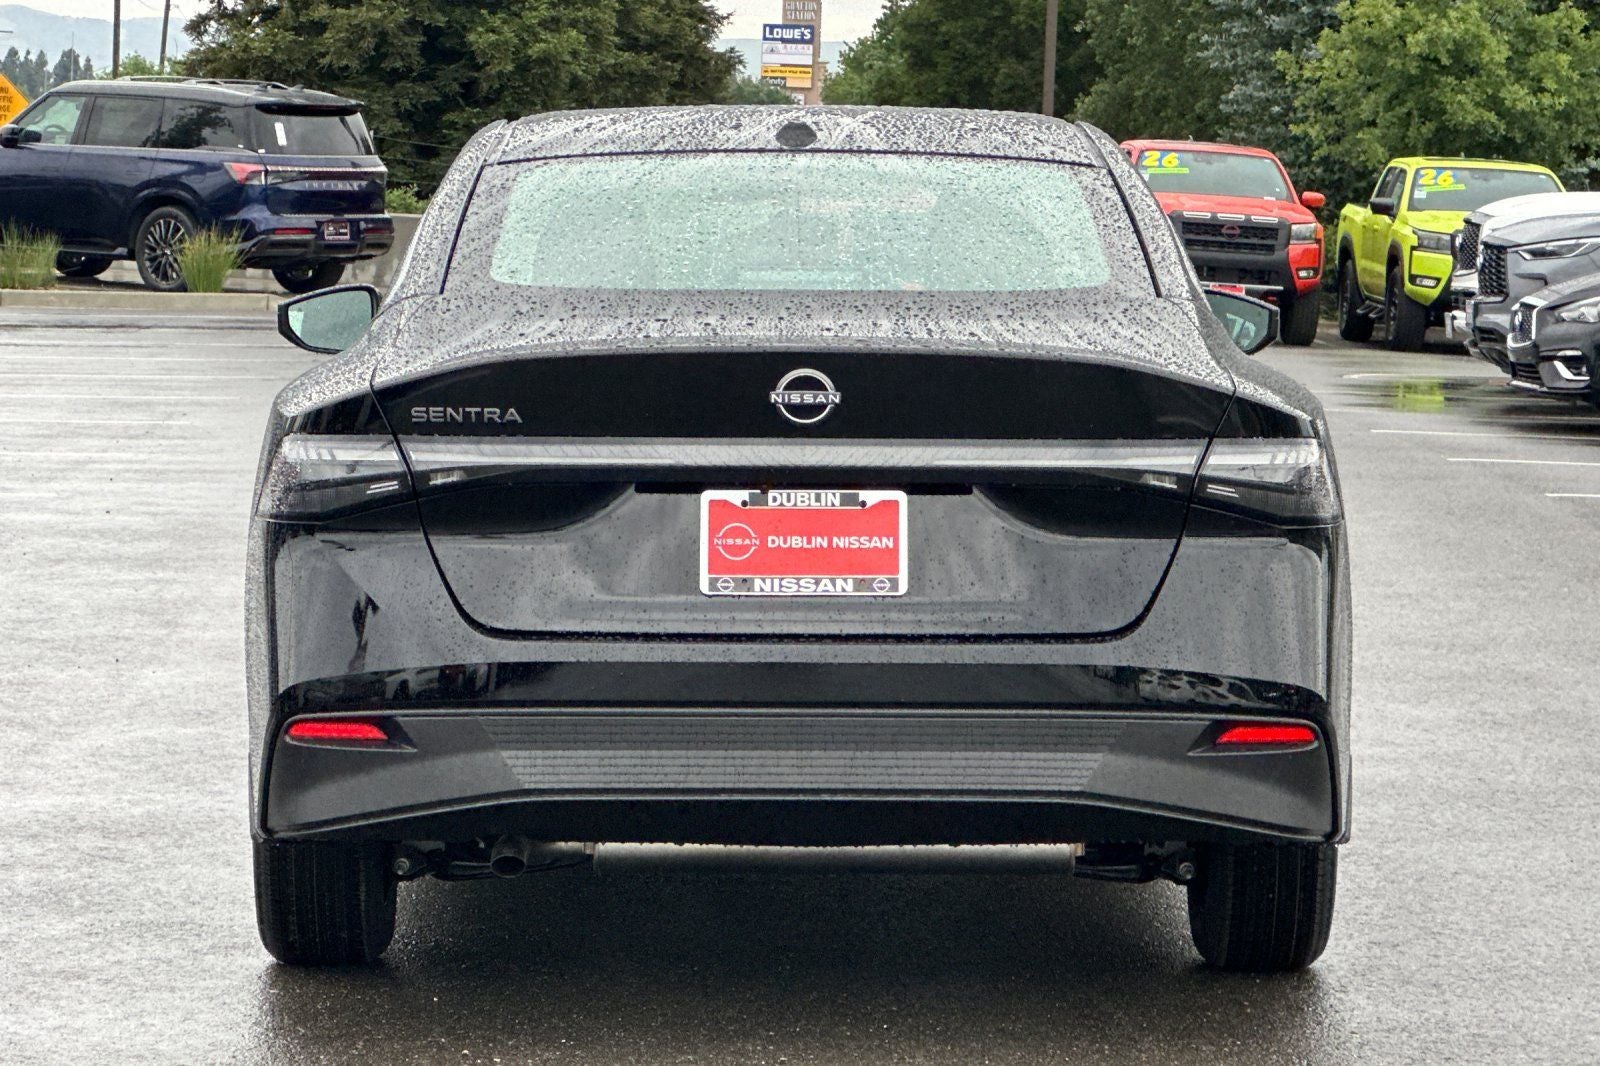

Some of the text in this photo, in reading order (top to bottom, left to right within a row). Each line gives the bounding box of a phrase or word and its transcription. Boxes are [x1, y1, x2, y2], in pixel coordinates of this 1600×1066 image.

[765, 26, 811, 39] LOWE'S
[1142, 150, 1179, 168] 26
[1418, 168, 1454, 186] 26
[771, 393, 840, 403] NISSAN
[411, 406, 523, 423] SENTRA
[767, 492, 841, 507] DUBLIN
[767, 535, 893, 548] DUBLIN NISSAN
[754, 578, 854, 592] NISSAN
